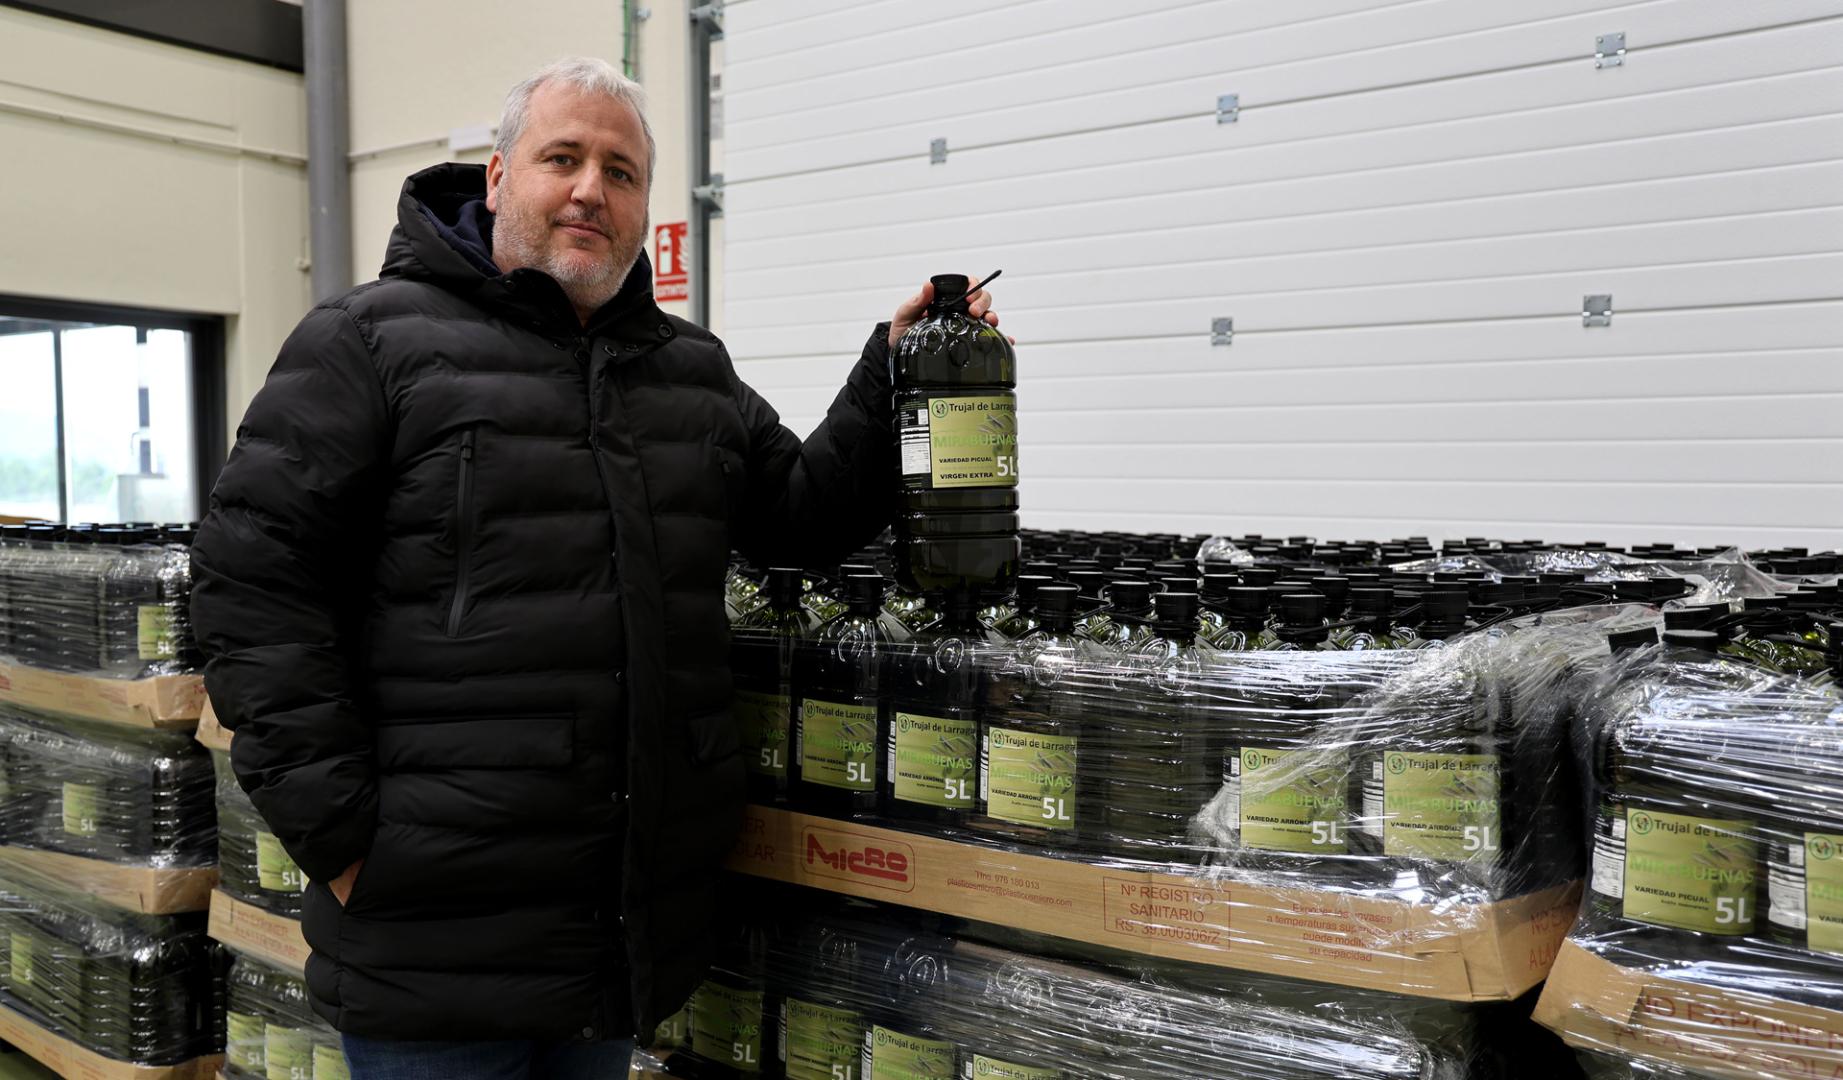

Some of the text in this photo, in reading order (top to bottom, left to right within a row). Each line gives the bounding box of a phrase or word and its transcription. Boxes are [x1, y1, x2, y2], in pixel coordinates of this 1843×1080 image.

[949, 402, 975, 412] Trujal
[977, 402, 989, 411] de
[933, 432, 1018, 448] MIRBUENAS
[996, 455, 1017, 477] 5L
[940, 471, 993, 480] VIRGEN EXTRA
[816, 705, 834, 716] Trujal
[835, 708, 844, 717] de
[910, 720, 931, 732] Trujal
[932, 723, 942, 732] de
[1005, 735, 1076, 752] Trujal de Larraga
[760, 748, 783, 769] 5L
[1408, 758, 1439, 771] Trujal
[1442, 760, 1456, 770] de
[846, 761, 872, 783] 5L
[944, 778, 971, 800] 5L
[992, 788, 1018, 798] VARIEDAD
[1042, 797, 1070, 820] 5L
[80, 818, 96, 832] 5L
[1246, 814, 1279, 824] VARIEDAD
[1654, 819, 1691, 835] Trujal
[1694, 824, 1711, 835] de
[1312, 820, 1344, 845] 5L
[1463, 826, 1497, 851] 5L
[1629, 855, 1755, 885] MIRBUENAS
[281, 872, 300, 887] 5L
[1121, 884, 1214, 906] Nº REGISTRO
[1634, 885, 1710, 904] VARIEDAD PICUAL
[1129, 902, 1205, 924] SANITARIO
[1714, 896, 1751, 924] 5L
[1115, 917, 1138, 934] RS.
[1274, 915, 1337, 931] temperaturas
[1303, 931, 1333, 944] puede
[1322, 949, 1372, 962] capacidad
[659, 1021, 684, 1040] 5L
[888, 1034, 909, 1048] Trujal
[910, 1042, 920, 1051] de
[732, 1042, 756, 1063] 5L
